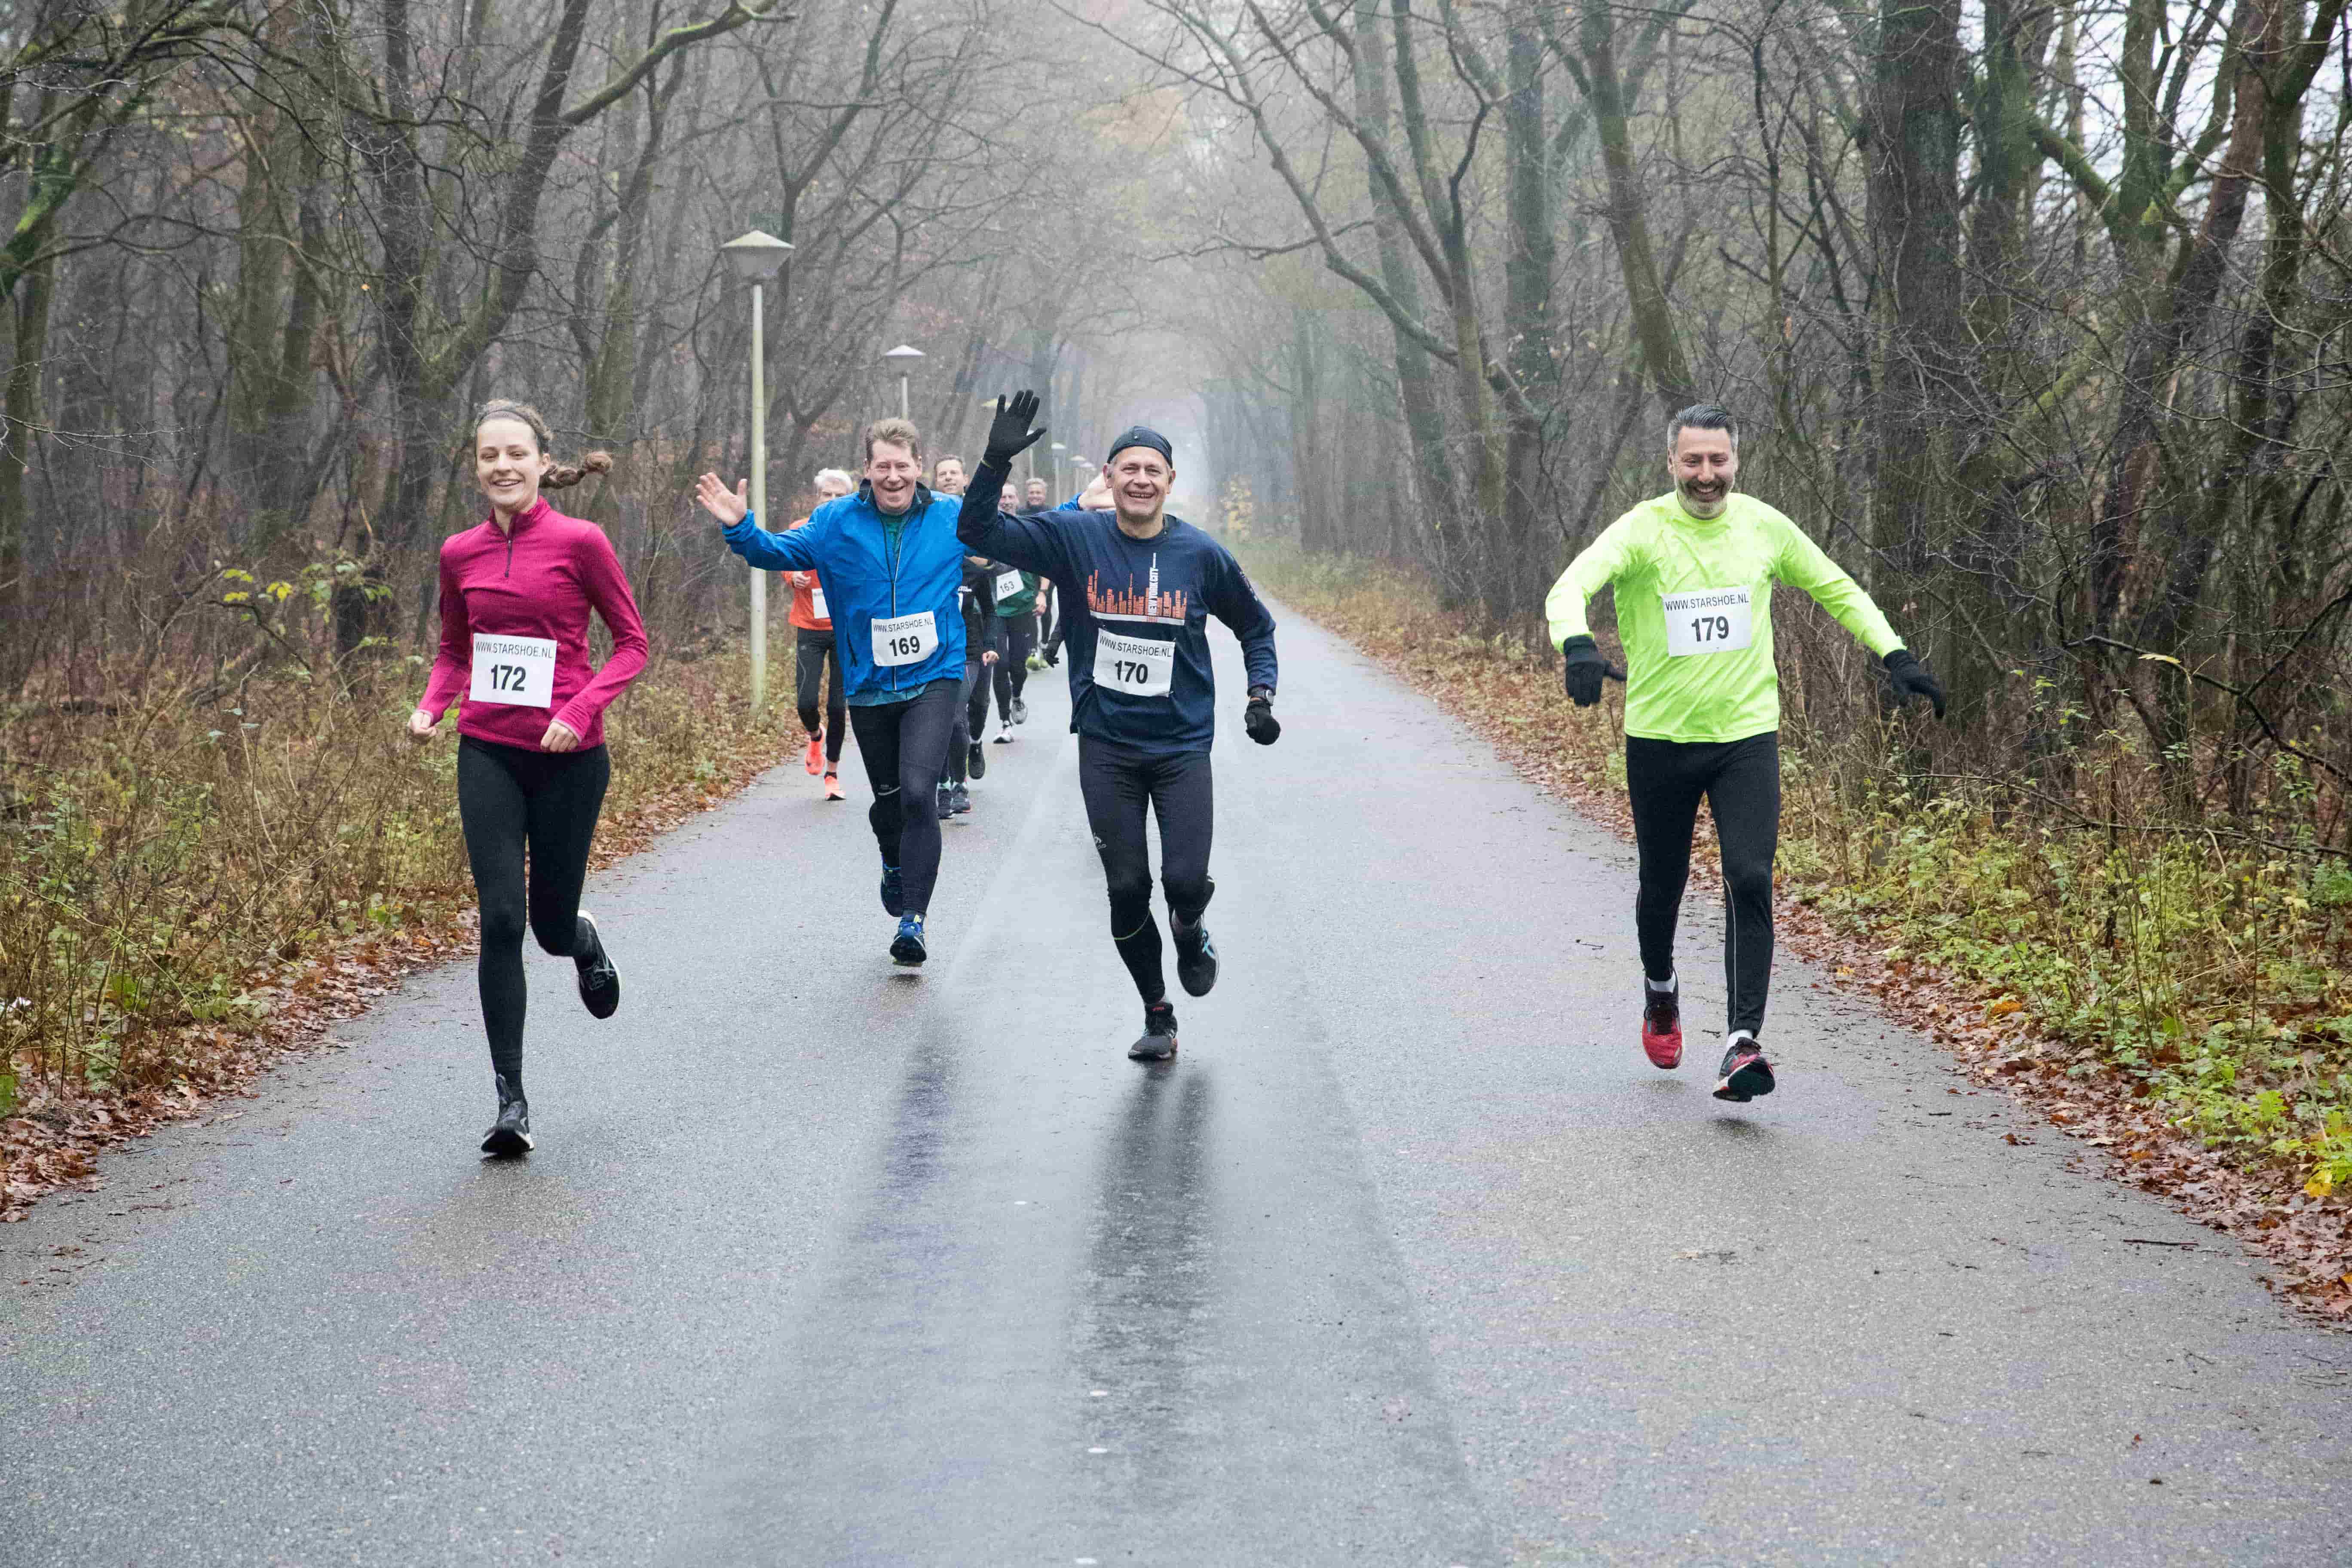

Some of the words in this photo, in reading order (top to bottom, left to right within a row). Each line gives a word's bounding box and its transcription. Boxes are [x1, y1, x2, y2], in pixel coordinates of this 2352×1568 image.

[1149, 567, 1159, 582] CITY
[1000, 581, 1014, 593] 163
[1149, 582, 1158, 599] YORK
[1148, 599, 1158, 616] NEW
[1665, 593, 1749, 611] WWW.STARSHOE.NL
[873, 617, 934, 633] WWW.STARSHOE.NL
[1691, 616, 1729, 642] 179
[475, 642, 553, 658] WWW.STARSHOE.NL
[889, 636, 920, 656] 169
[1100, 636, 1172, 657] WWW.STARSHOE.NL
[491, 665, 526, 691] 172
[1115, 660, 1148, 684] 170
